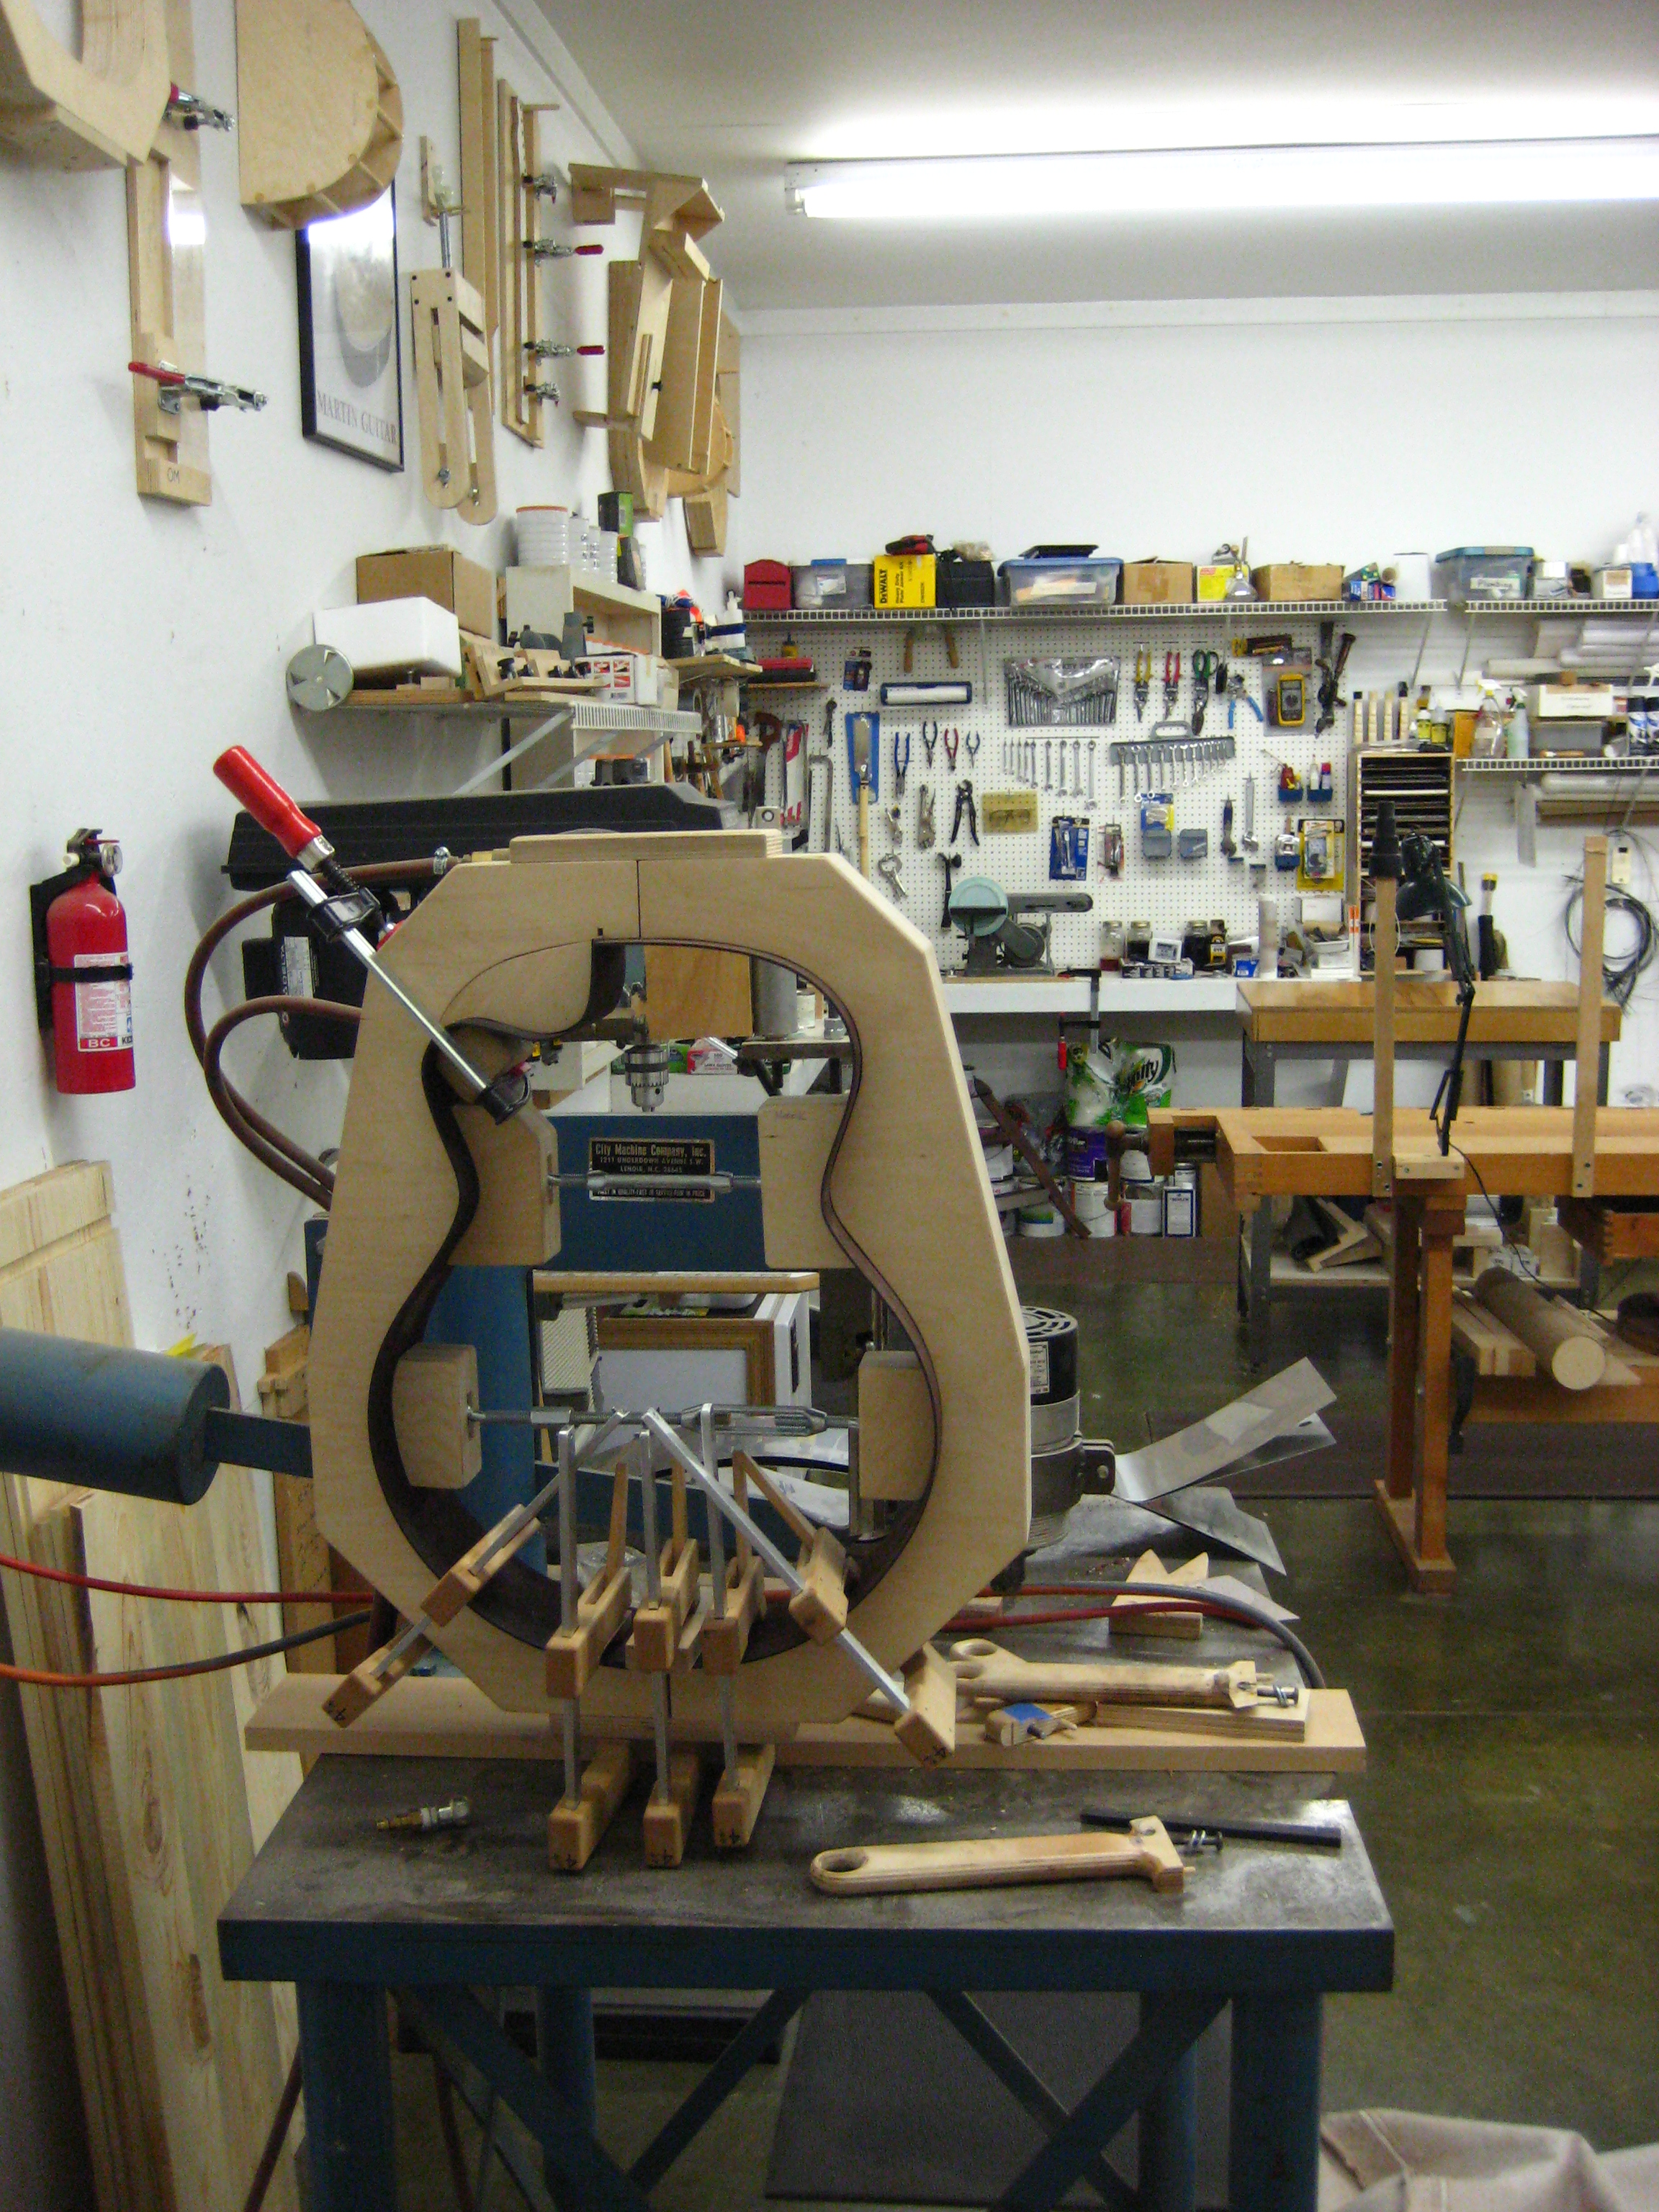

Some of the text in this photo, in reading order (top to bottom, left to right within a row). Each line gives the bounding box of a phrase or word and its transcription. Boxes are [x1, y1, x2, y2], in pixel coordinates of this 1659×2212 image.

[316, 390, 397, 445] MARTIN GUITAR
[167, 467, 180, 483] OM
[88, 1038, 111, 1048] BC
[595, 1143, 707, 1158] City Machine Company, Inc.
